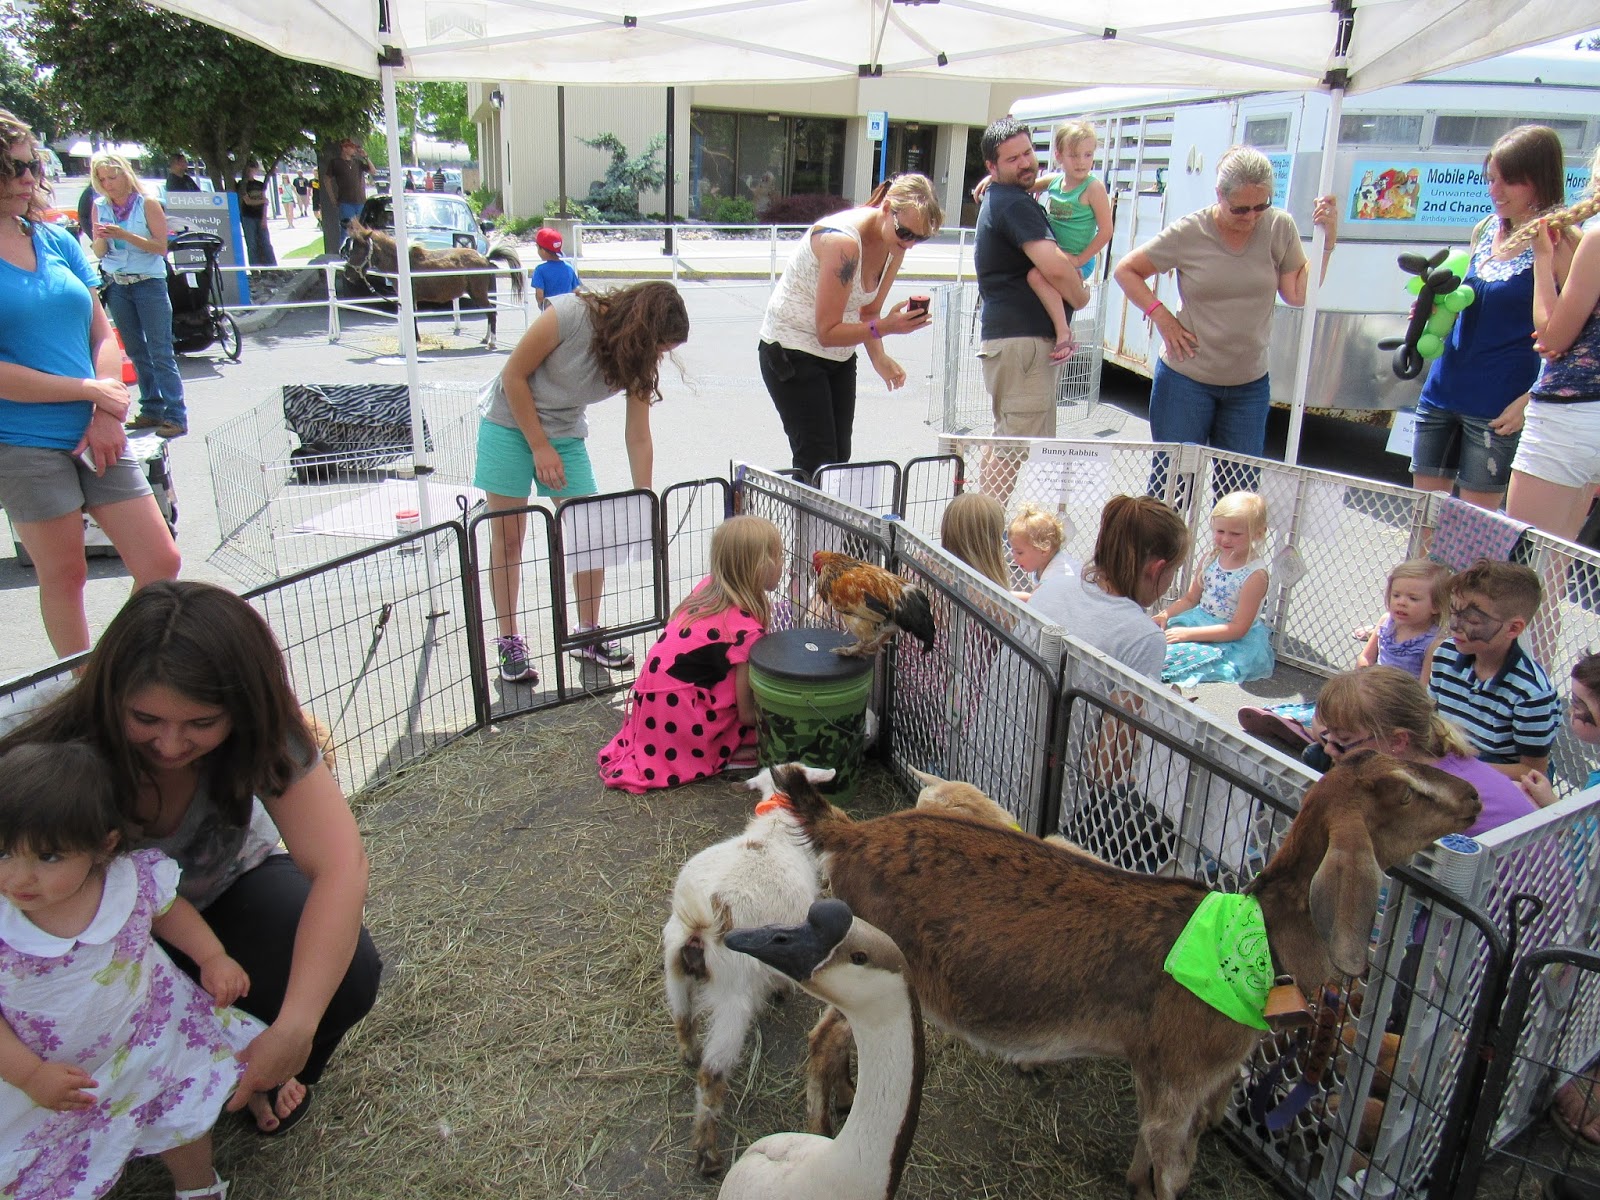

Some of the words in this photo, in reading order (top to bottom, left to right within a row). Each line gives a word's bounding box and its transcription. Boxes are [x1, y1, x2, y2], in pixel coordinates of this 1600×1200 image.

[1427, 168, 1465, 184] Mobile
[170, 196, 211, 205] CHASE
[1423, 201, 1447, 212] 2nd
[1450, 201, 1492, 213] Chance
[1042, 447, 1067, 456] Bunny
[1068, 448, 1099, 457] Rabbits
